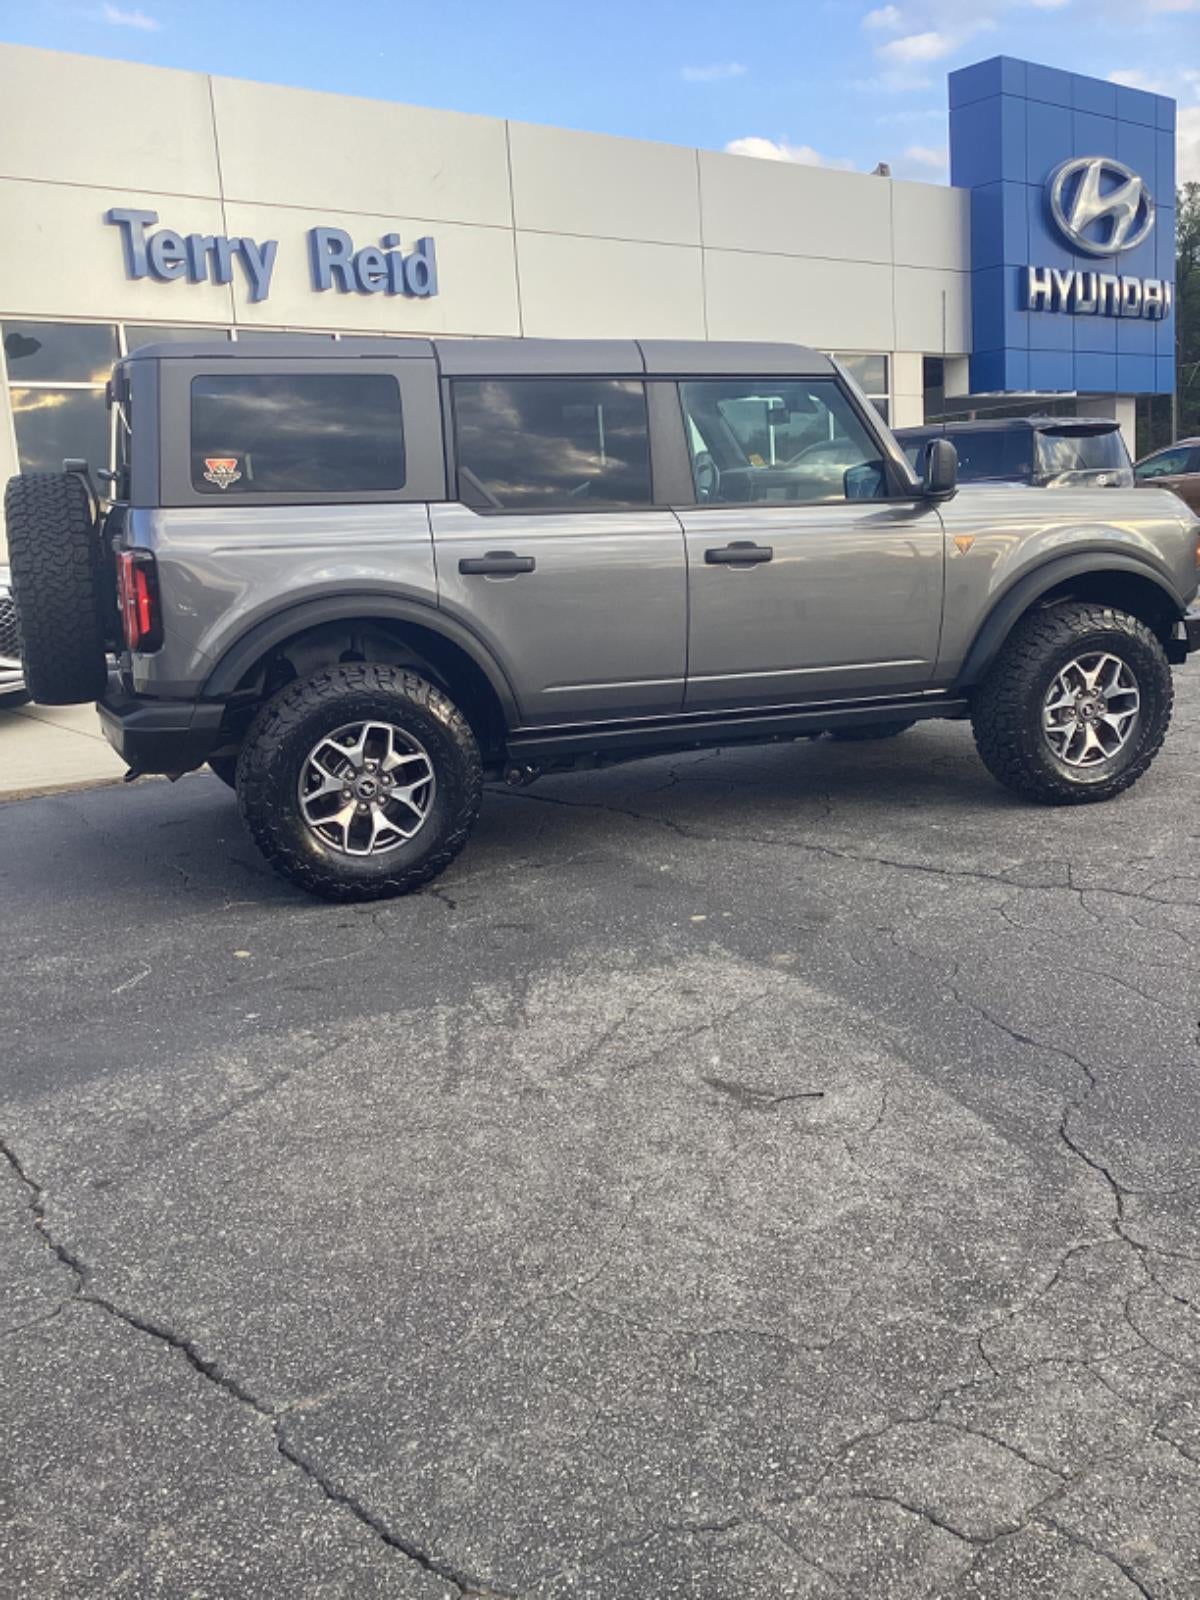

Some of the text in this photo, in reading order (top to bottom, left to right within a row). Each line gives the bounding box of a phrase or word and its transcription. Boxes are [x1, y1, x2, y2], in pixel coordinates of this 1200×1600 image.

[106, 207, 438, 302] Terry Reid
[1026, 265, 1172, 320] HYUNDAI
